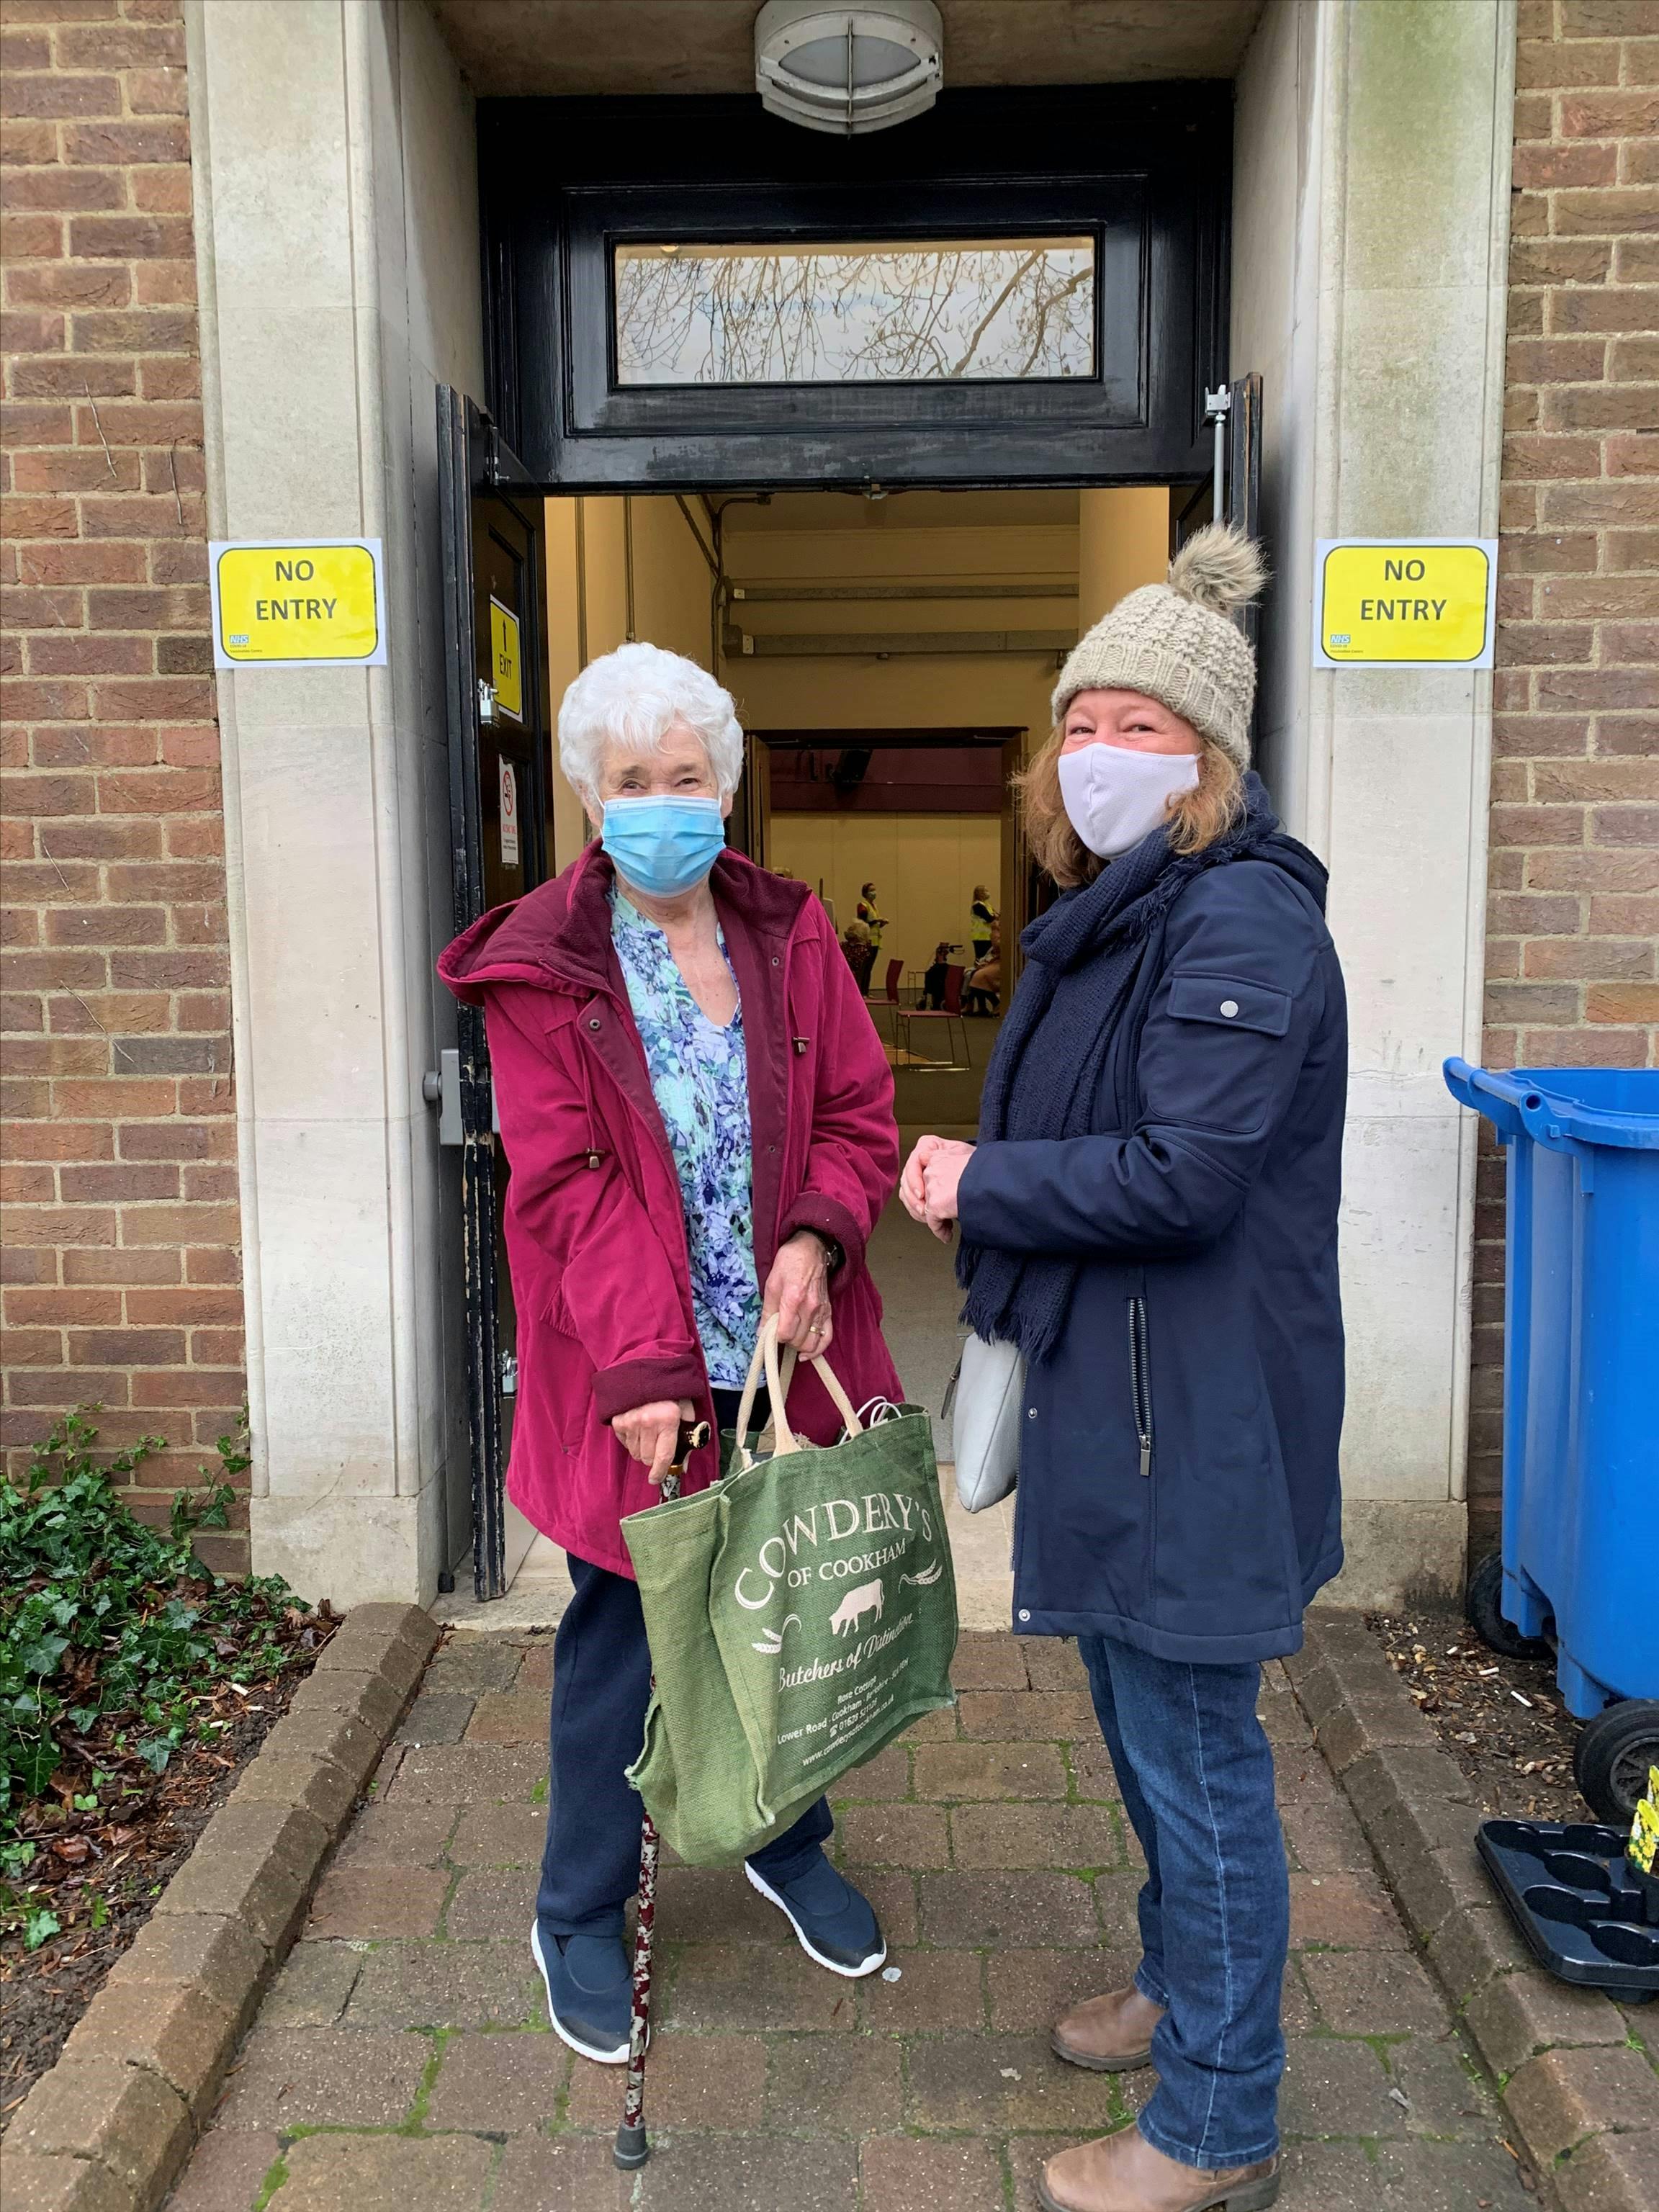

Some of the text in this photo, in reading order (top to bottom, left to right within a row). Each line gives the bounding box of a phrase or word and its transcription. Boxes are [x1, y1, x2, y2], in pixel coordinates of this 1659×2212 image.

[275, 559, 315, 582] NO
[1385, 559, 1426, 581] NO
[256, 598, 338, 621] ENTRY
[1360, 599, 1447, 621] ENTRY
[230, 634, 249, 644] NHS
[1331, 634, 1351, 644] NHS
[499, 652, 512, 680] EXIT
[734, 1493, 932, 1610] COWDERY'S
[787, 1537, 907, 1588] OF COOKHAM
[778, 1657, 844, 1692] Butchers
[845, 1642, 862, 1670] of
[837, 1691, 853, 1705] Rose
[777, 1727, 804, 1745] Lower
[805, 1717, 827, 1735] Road
[832, 1699, 862, 1722] Cookham
